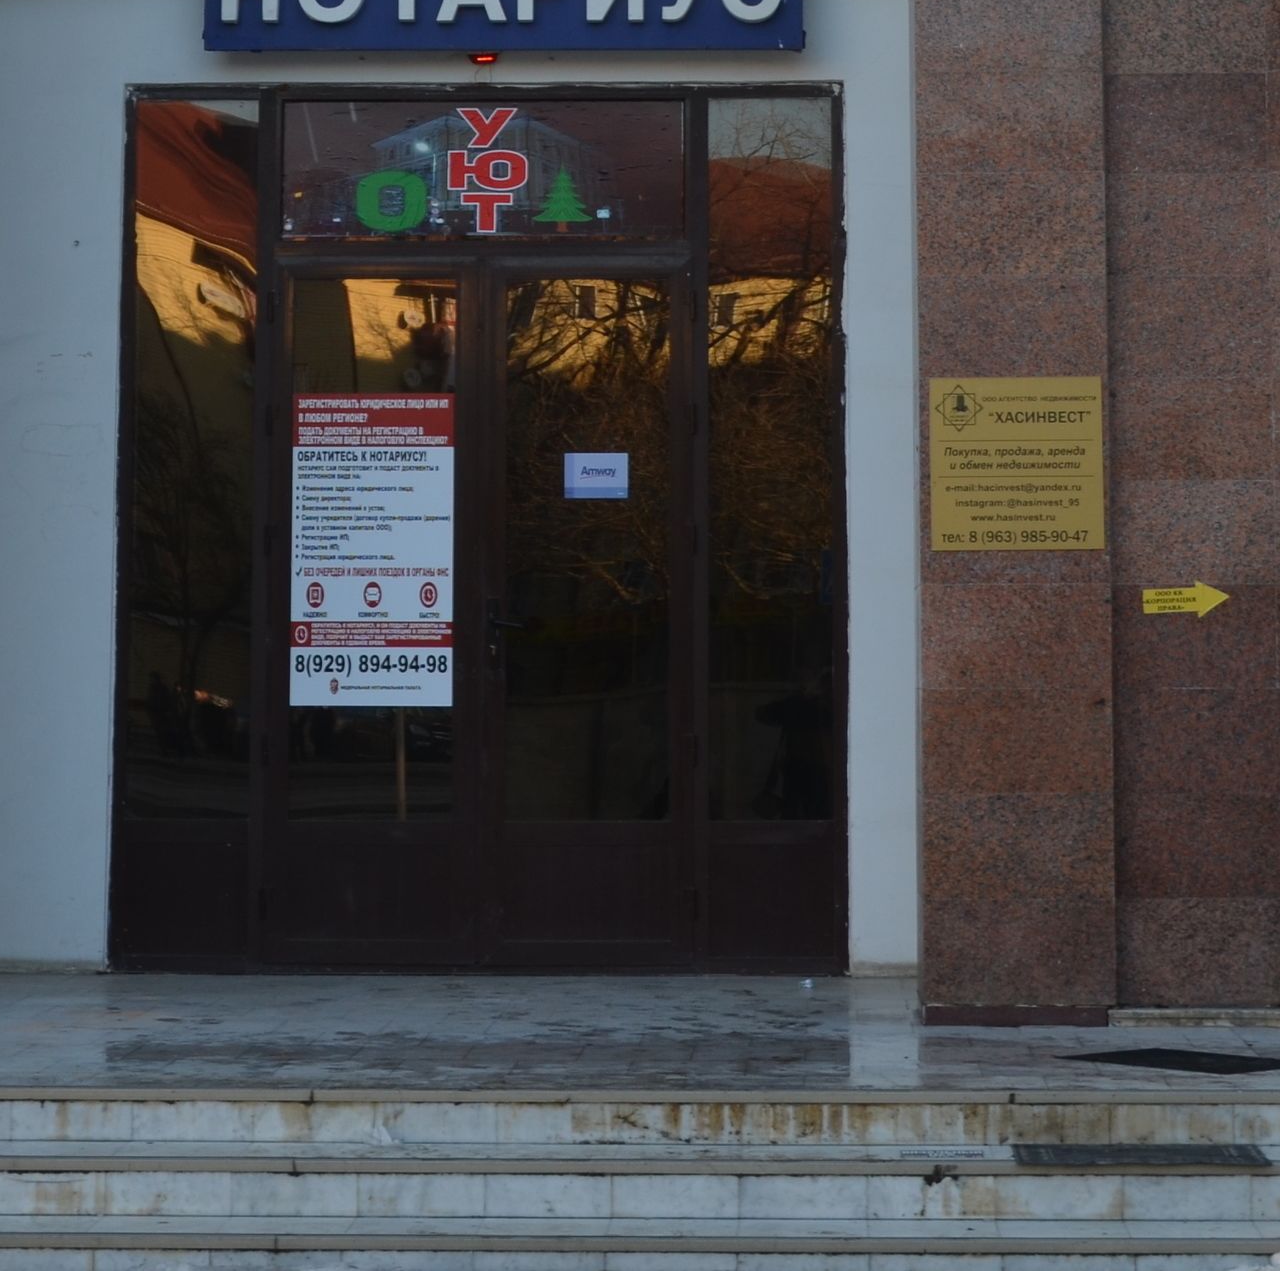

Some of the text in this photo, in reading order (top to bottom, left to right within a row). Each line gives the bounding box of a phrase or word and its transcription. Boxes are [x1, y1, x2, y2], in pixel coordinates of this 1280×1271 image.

[447, 107, 529, 234] УЮТ
[297, 451, 427, 462] ОБРАТИТЕСЬ К НОТАРИУСУ!
[944, 445, 1086, 459] Покупка, продажа, аренда
[580, 466, 617, 478] Amway
[950, 459, 1081, 471] и обмен недвижимости
[969, 531, 977, 543] 8
[981, 531, 1017, 545] (963)
[1021, 530, 1089, 543] 985-90-47
[295, 654, 448, 678] 8(929) 894-94-98
